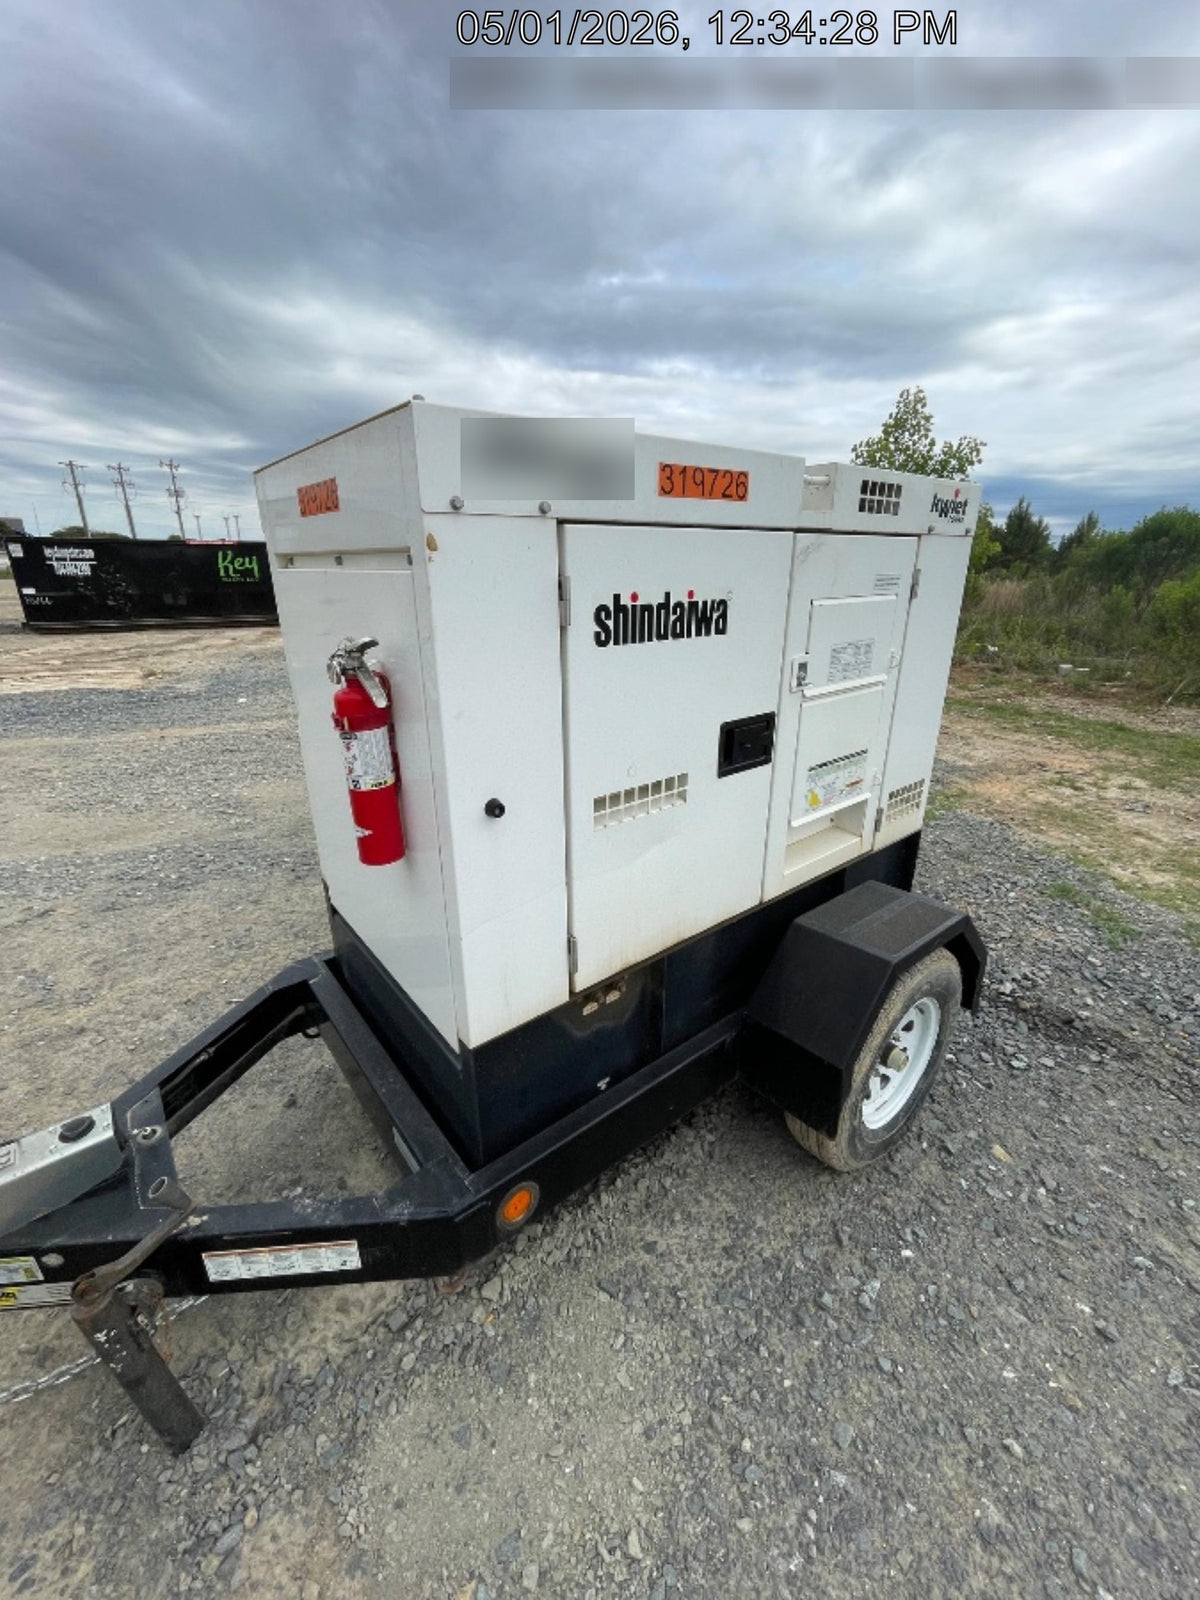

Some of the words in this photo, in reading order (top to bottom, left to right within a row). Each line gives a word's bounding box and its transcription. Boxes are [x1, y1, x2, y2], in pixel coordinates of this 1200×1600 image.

[660, 464, 749, 500] 319726
[218, 550, 259, 578] Key
[593, 589, 728, 648] shindaiwa
